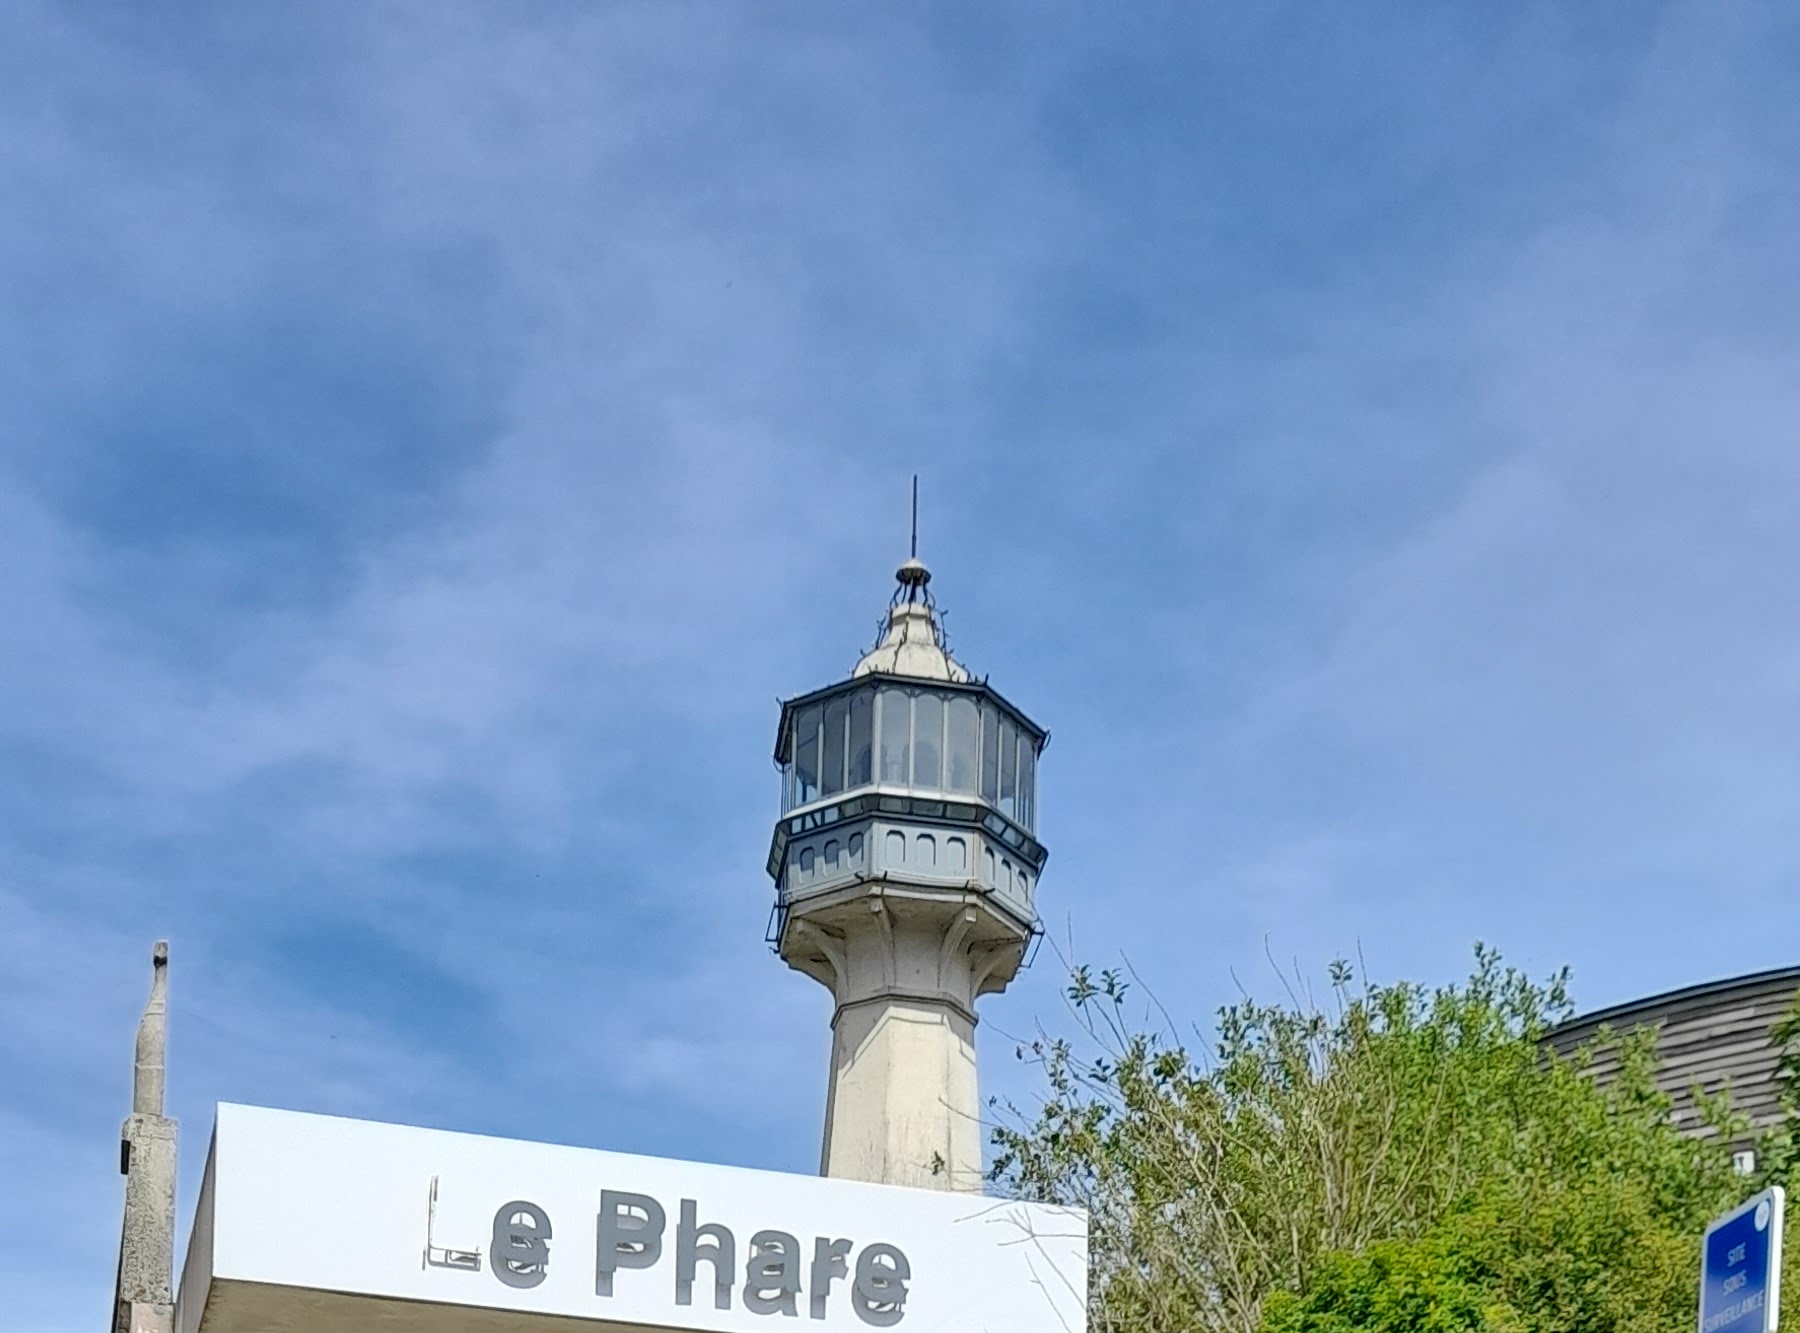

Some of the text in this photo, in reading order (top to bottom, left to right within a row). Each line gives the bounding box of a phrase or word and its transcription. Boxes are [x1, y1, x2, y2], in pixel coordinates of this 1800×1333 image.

[595, 1188, 911, 1327] Phare
[1727, 1241, 1747, 1267] SITE
[1722, 1269, 1748, 1296] SOUS
